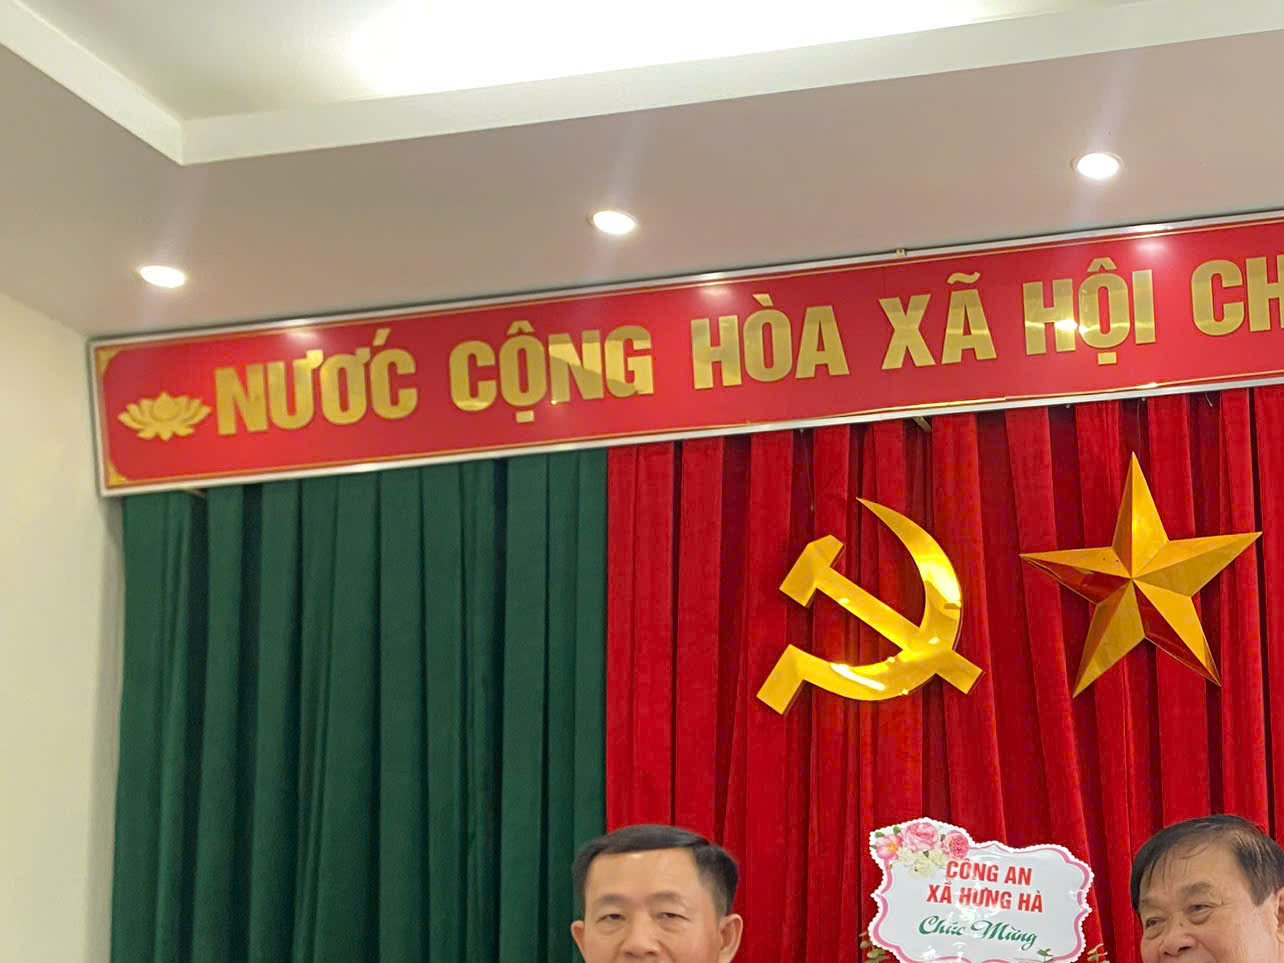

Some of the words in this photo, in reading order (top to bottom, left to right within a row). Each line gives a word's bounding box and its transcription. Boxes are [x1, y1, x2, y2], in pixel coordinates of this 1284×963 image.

[215, 327, 418, 435] NƯỚC
[449, 321, 654, 424] CỘNG
[690, 293, 849, 389] HÒA
[879, 272, 997, 370] XÃ
[1022, 256, 1158, 366] HỘI
[945, 858, 999, 883] CÔNG
[1004, 865, 1033, 886] AN
[925, 881, 953, 905] XÃ
[958, 886, 1013, 910] HƯNG
[1016, 889, 1044, 914] HÀ
